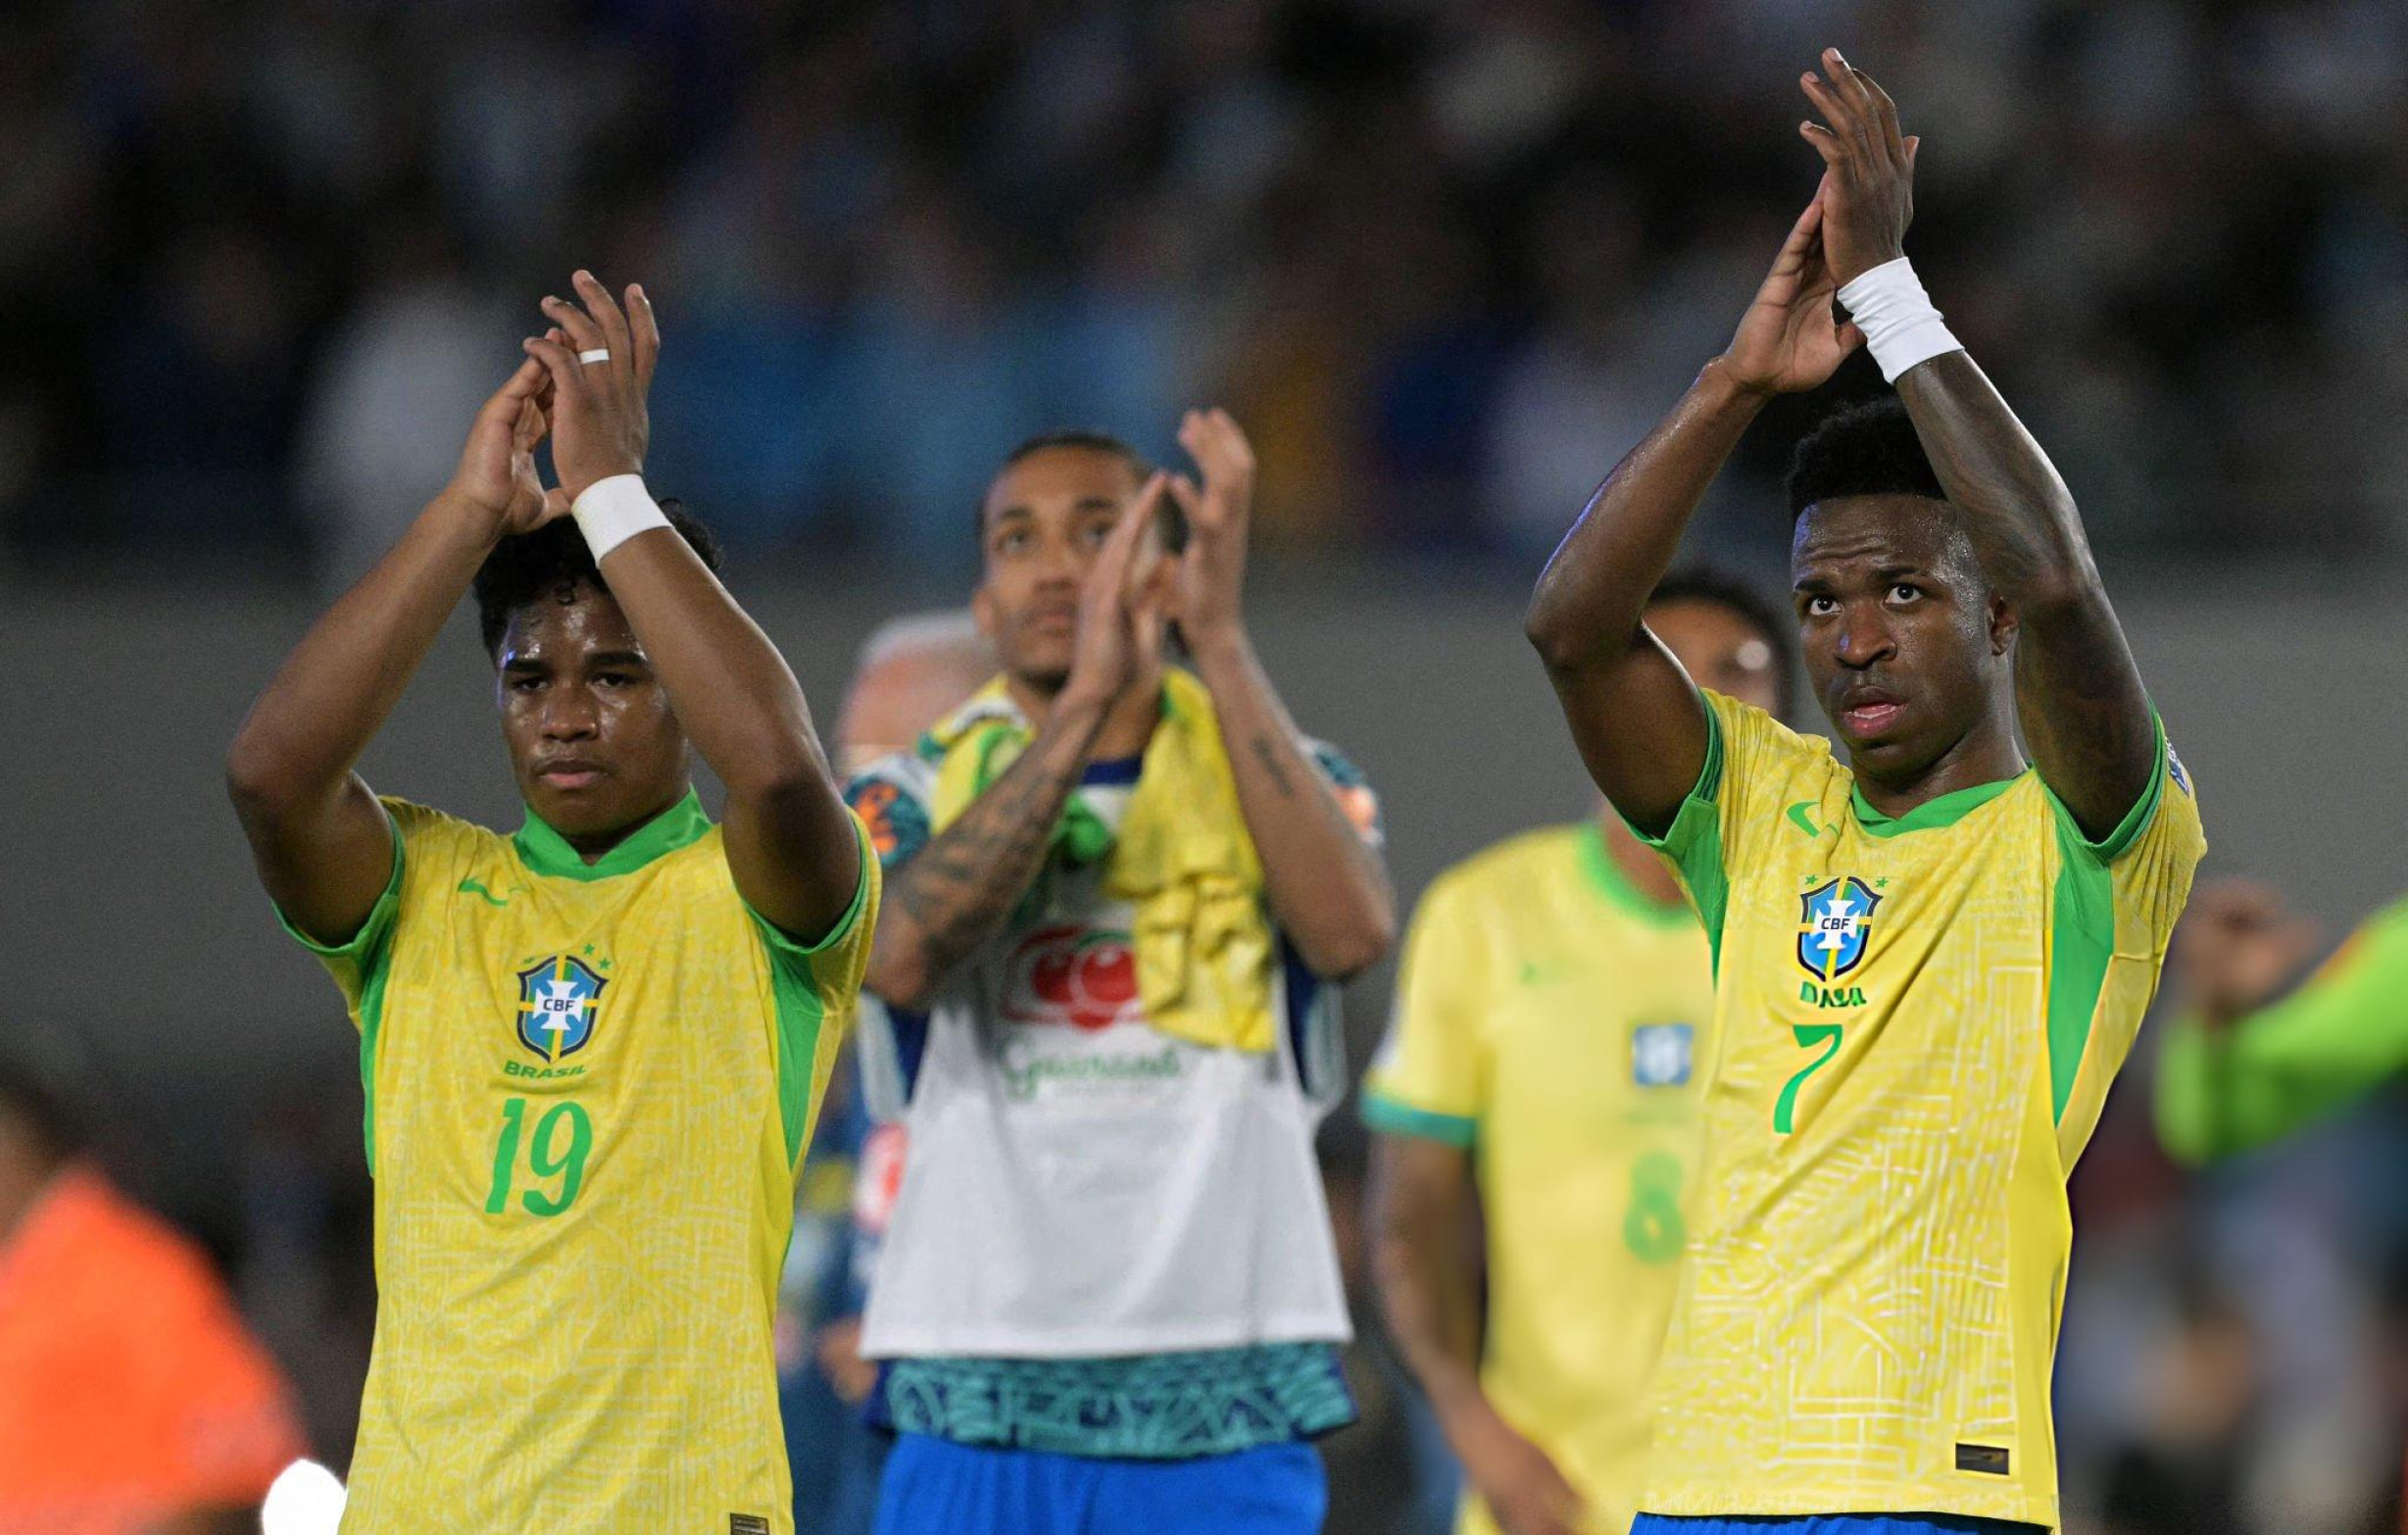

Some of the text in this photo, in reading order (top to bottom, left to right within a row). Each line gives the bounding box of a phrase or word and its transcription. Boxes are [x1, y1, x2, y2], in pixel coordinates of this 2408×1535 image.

[1820, 916, 1851, 931] CBF
[542, 998, 576, 1013] CBF
[503, 1060, 587, 1079] BRASIL
[1772, 1023, 1843, 1135] 7
[484, 1097, 593, 1217] 19
[1623, 1150, 1686, 1265] 8
